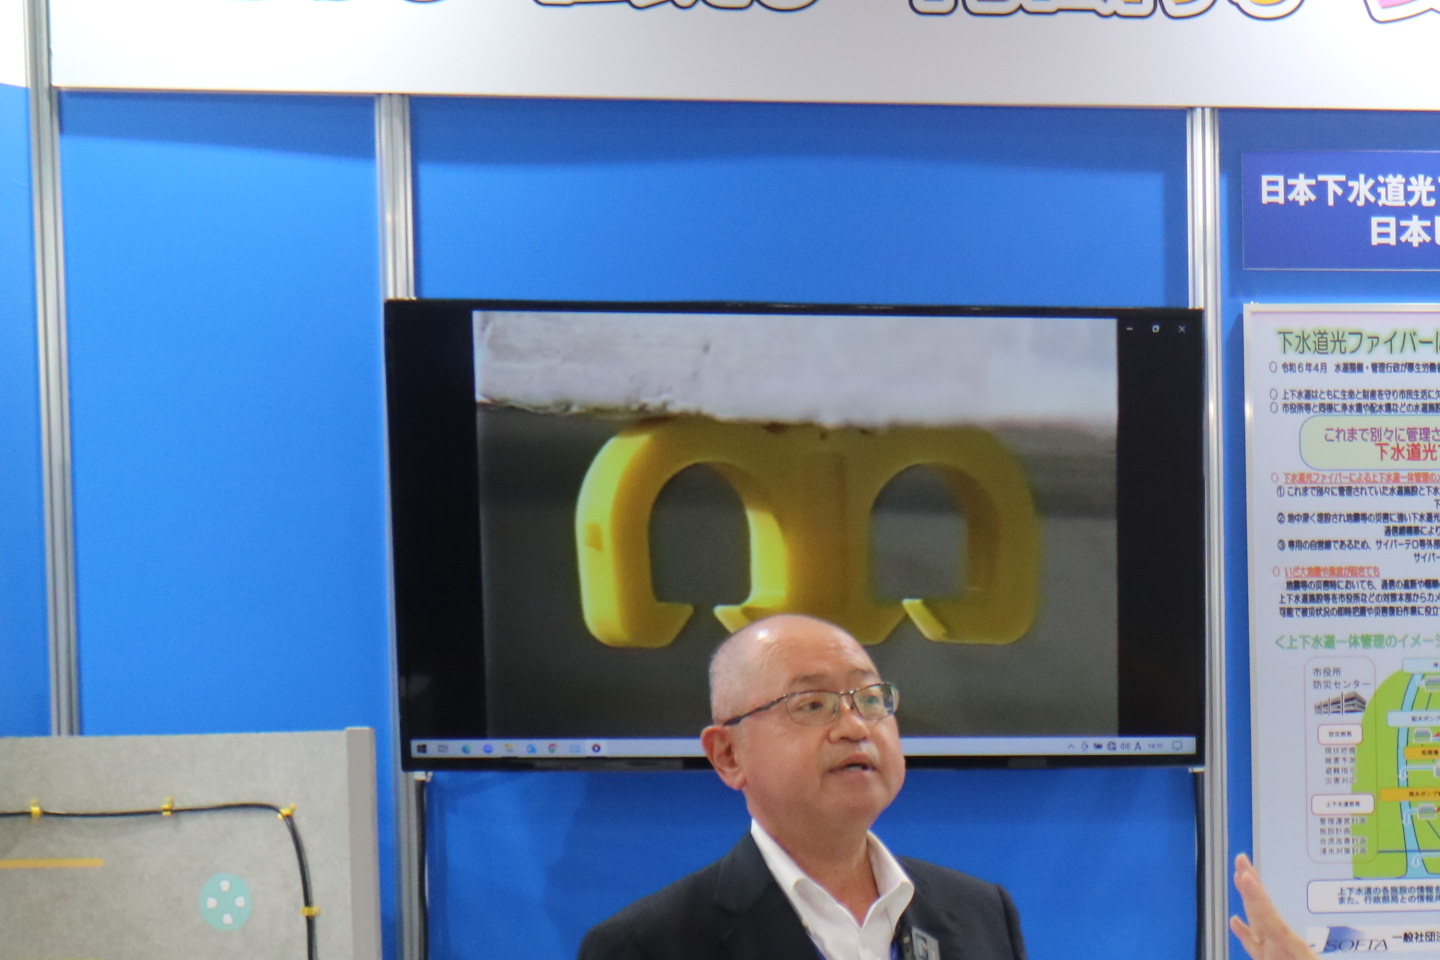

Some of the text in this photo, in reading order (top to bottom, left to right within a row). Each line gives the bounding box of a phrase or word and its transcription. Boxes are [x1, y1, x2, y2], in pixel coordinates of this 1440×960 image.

[1312, 667, 1342, 678] 市役所
[1313, 680, 1371, 690] 防災センター
